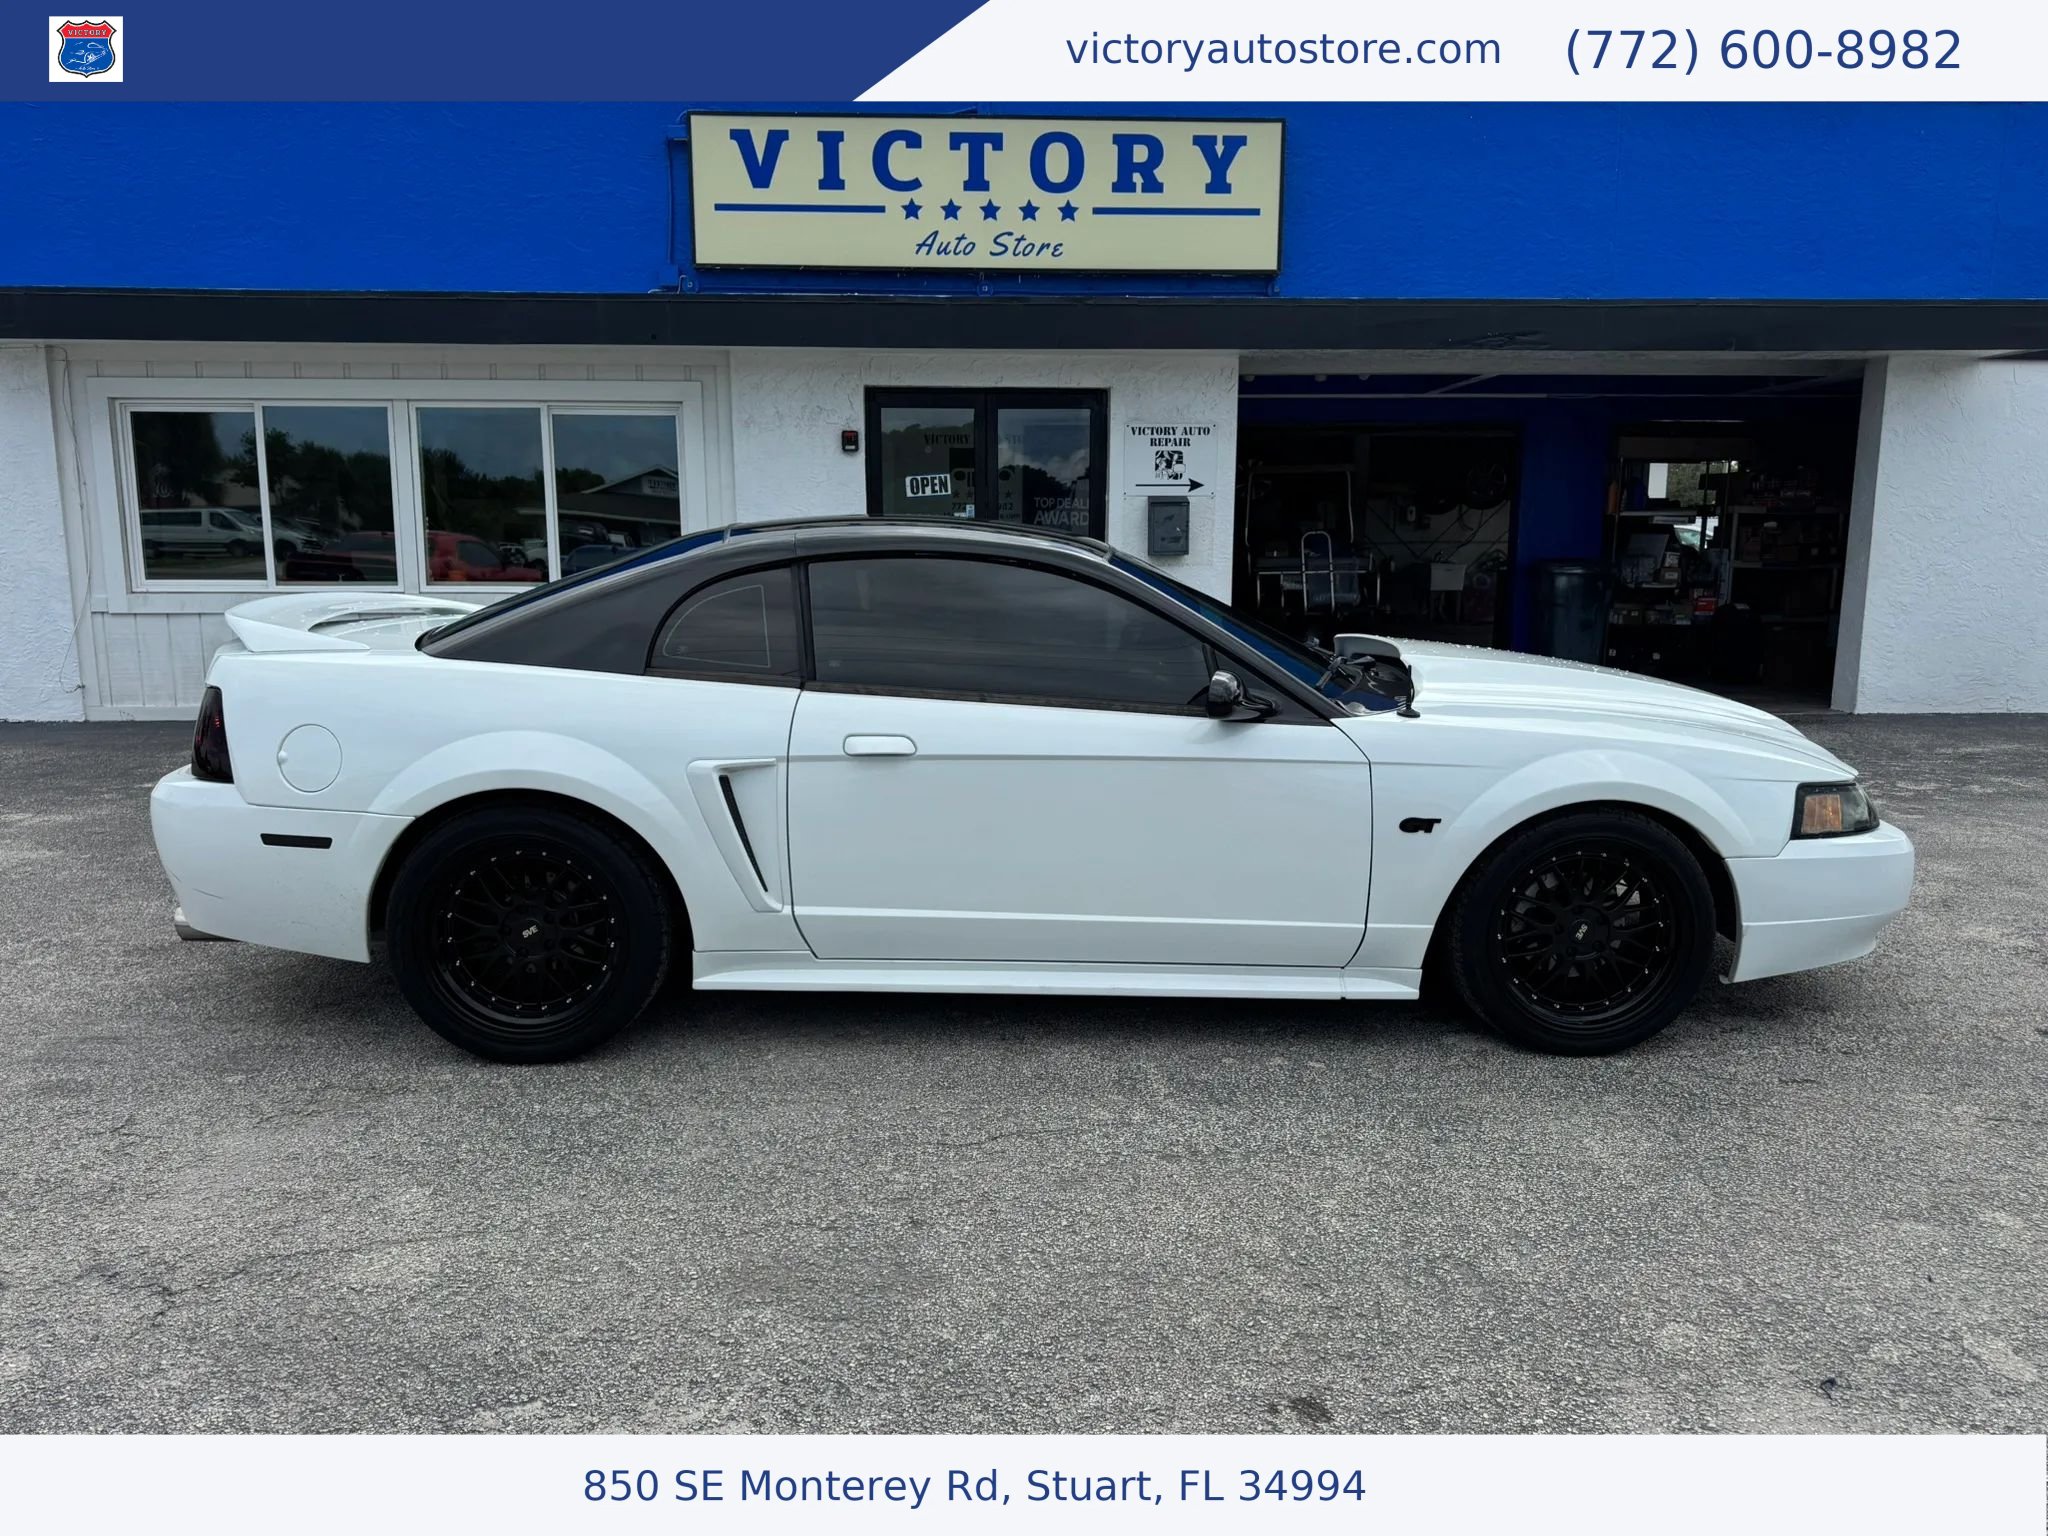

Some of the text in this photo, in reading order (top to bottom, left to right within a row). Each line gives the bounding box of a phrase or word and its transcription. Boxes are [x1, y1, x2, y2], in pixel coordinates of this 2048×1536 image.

[729, 128, 1248, 194] VICTORY
[915, 229, 1064, 258] Auto Store
[1130, 426, 1211, 436] VICTORY AUTO
[923, 433, 969, 445] VICTORY
[1150, 437, 1191, 447] REPAIR
[909, 476, 948, 495] OPEN
[1033, 497, 1055, 508] TOP
[1399, 816, 1442, 833] GT
[522, 925, 538, 938] SVE
